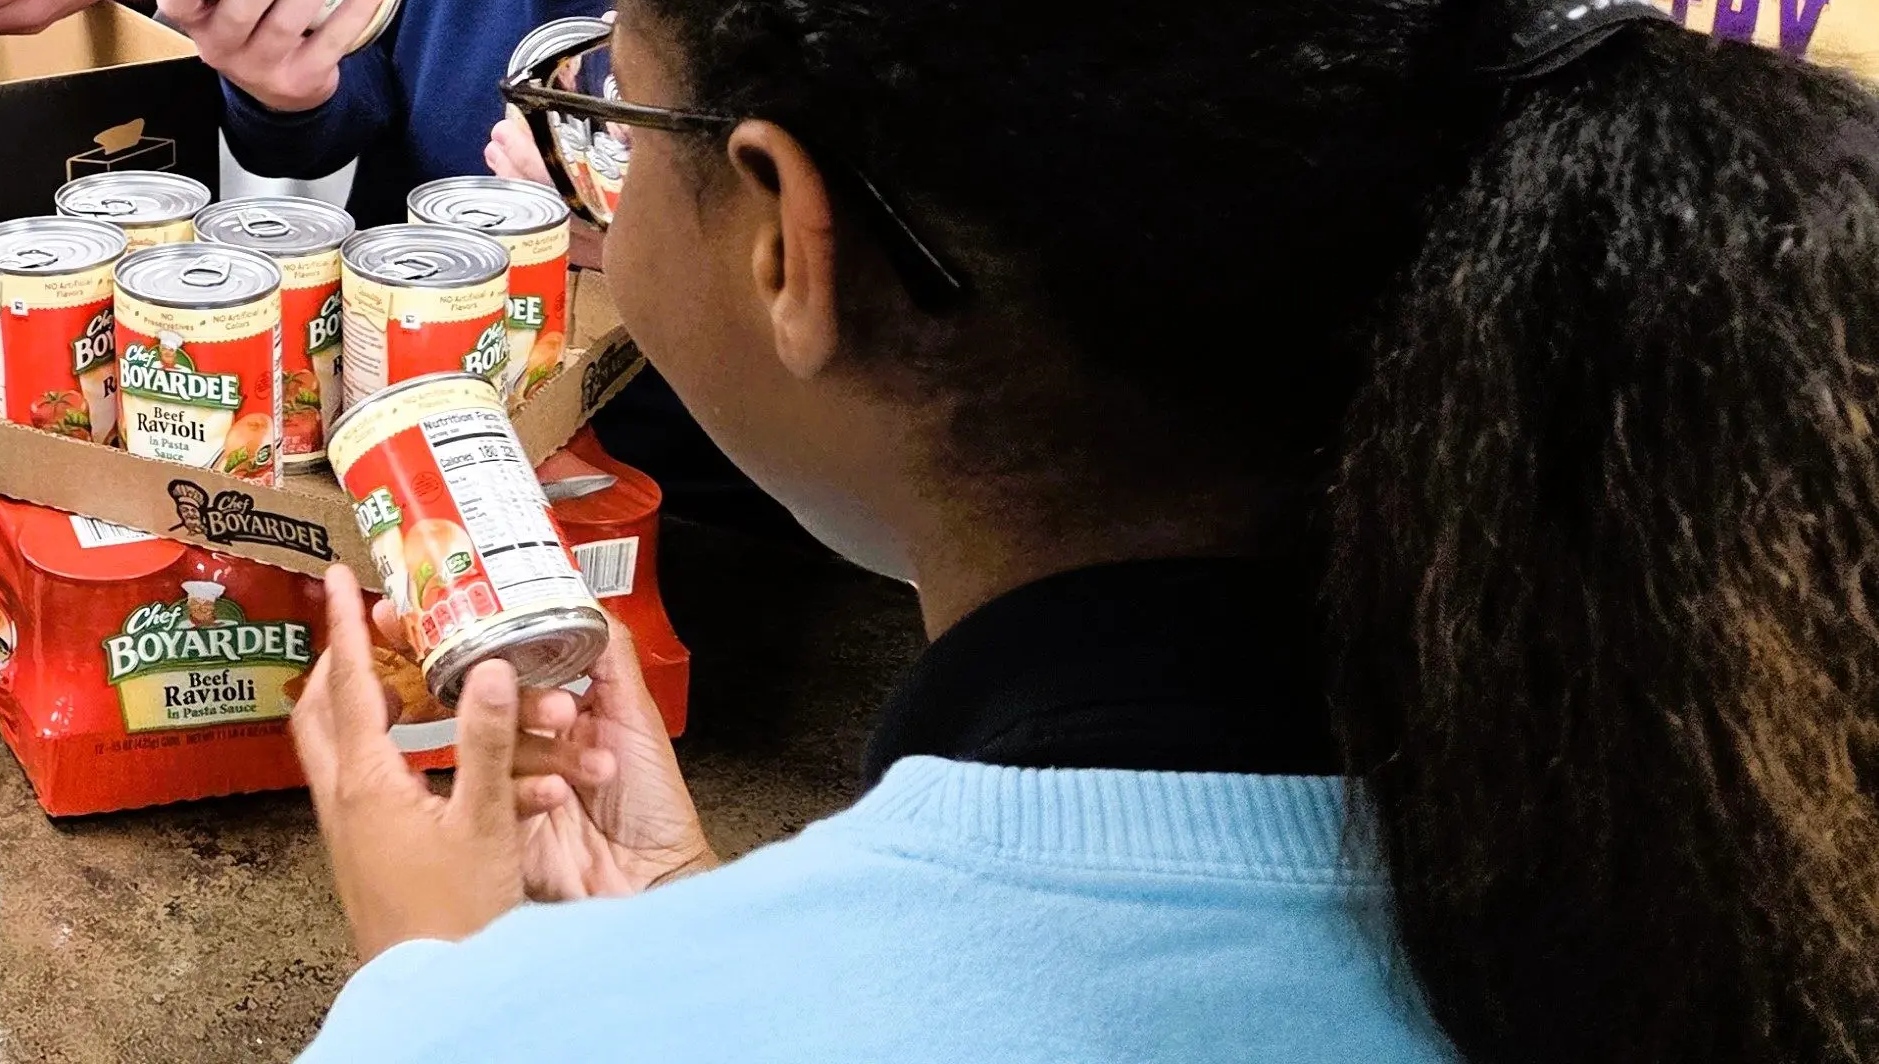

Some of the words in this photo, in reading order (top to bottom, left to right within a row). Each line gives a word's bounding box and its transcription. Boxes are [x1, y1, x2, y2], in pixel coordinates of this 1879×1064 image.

[44, 282, 58, 290] NO
[161, 313, 174, 321] NO
[228, 309, 259, 321] Artificial
[143, 317, 195, 332] Preservatives
[225, 321, 250, 331] Colors
[125, 342, 158, 370] Chef
[119, 357, 240, 407] BOYARDEE
[153, 406, 185, 423] Beef
[423, 413, 474, 432] Nutrition
[137, 412, 206, 443] Ravioli
[149, 436, 160, 447] In
[161, 436, 190, 451] Pasta
[154, 447, 184, 462] Sauce
[439, 452, 474, 469] Calories
[218, 495, 249, 514] Chef
[207, 510, 328, 556] BOYARDEE
[126, 602, 182, 634] Chef
[107, 622, 310, 679] BOYARDEE
[189, 669, 231, 688] Beef
[164, 679, 256, 708] Ravioli
[167, 707, 180, 720] In
[183, 702, 217, 718] Pasta
[219, 702, 258, 715] Sauce
